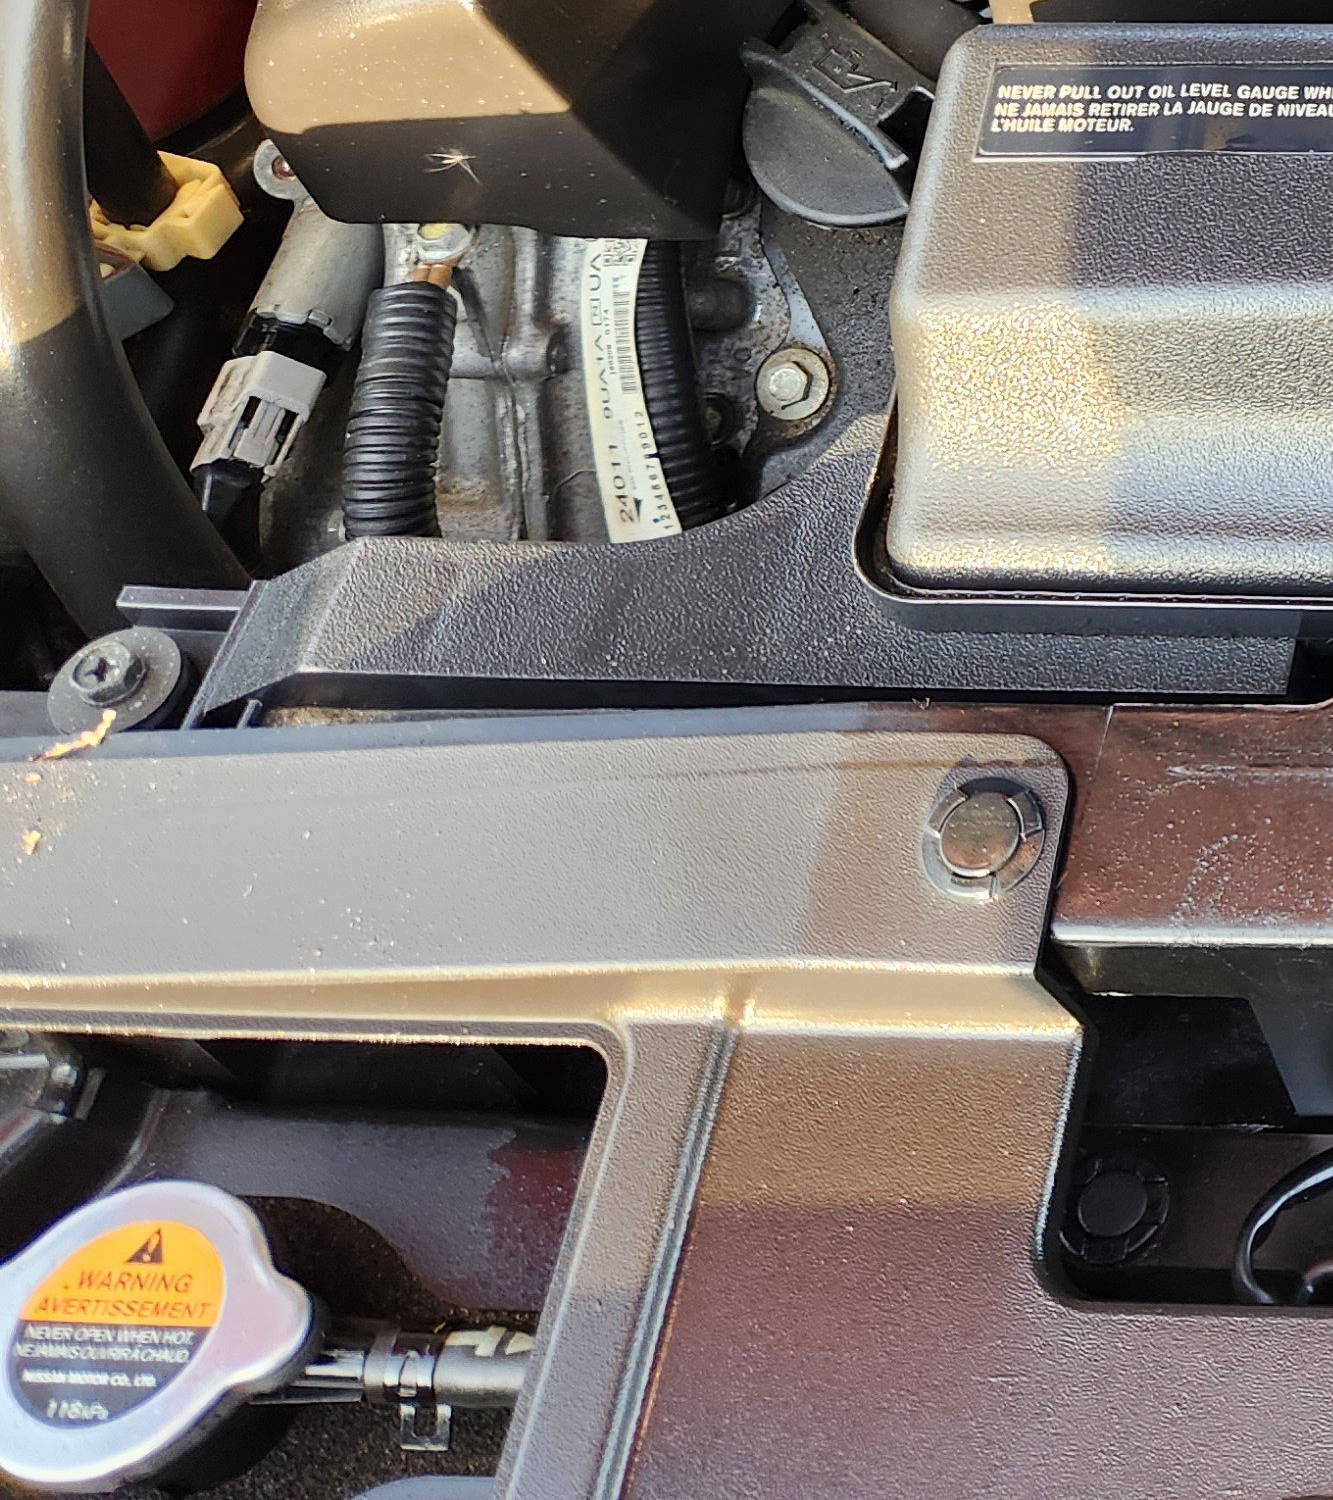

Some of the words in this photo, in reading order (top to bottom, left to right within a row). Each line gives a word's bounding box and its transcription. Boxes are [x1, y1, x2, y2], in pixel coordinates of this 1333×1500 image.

[998, 85, 1056, 100] NEVER
[1059, 84, 1102, 99] PULL
[1107, 85, 1145, 100] OUT
[1148, 85, 1176, 99] OIL
[1180, 82, 1231, 99] LEVEL
[1236, 84, 1300, 100] GAUGE
[994, 102, 1020, 117] NE
[1021, 102, 1085, 118] JAMAIS
[1088, 101, 1161, 117] RETIRER
[1163, 101, 1183, 116] LA
[1187, 100, 1246, 116] JAUGE
[1248, 102, 1274, 117] DE
[990, 117, 1056, 133] L'HUILE
[1058, 117, 1134, 133] MOTEUR.
[606, 444, 635, 523] 24011
[78, 1270, 193, 1293] WARNING
[35, 1297, 211, 1319] AVERTISSEMENT
[24, 1324, 73, 1341] NEVER
[75, 1326, 114, 1343] OPEN
[117, 1328, 160, 1345] WHEN
